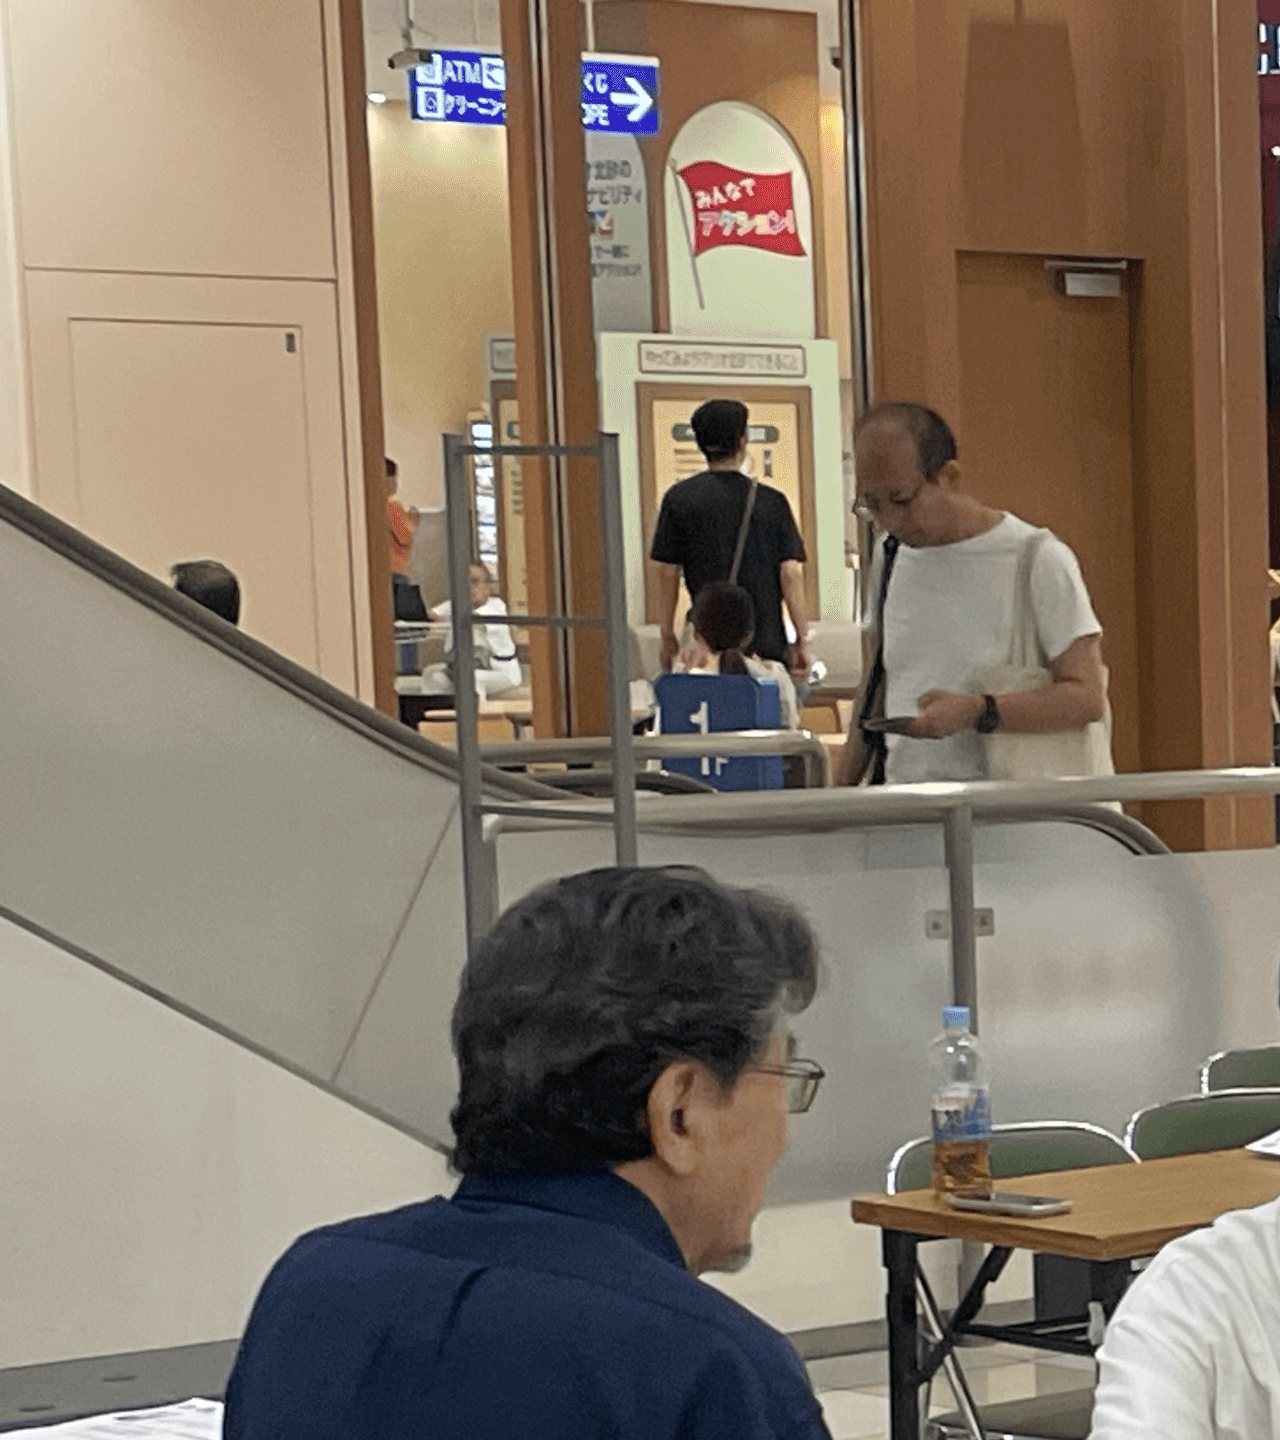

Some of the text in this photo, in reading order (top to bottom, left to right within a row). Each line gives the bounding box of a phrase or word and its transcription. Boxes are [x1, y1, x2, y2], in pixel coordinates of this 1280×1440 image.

[444, 59, 481, 84] ATM
[694, 178, 756, 209] みんなで
